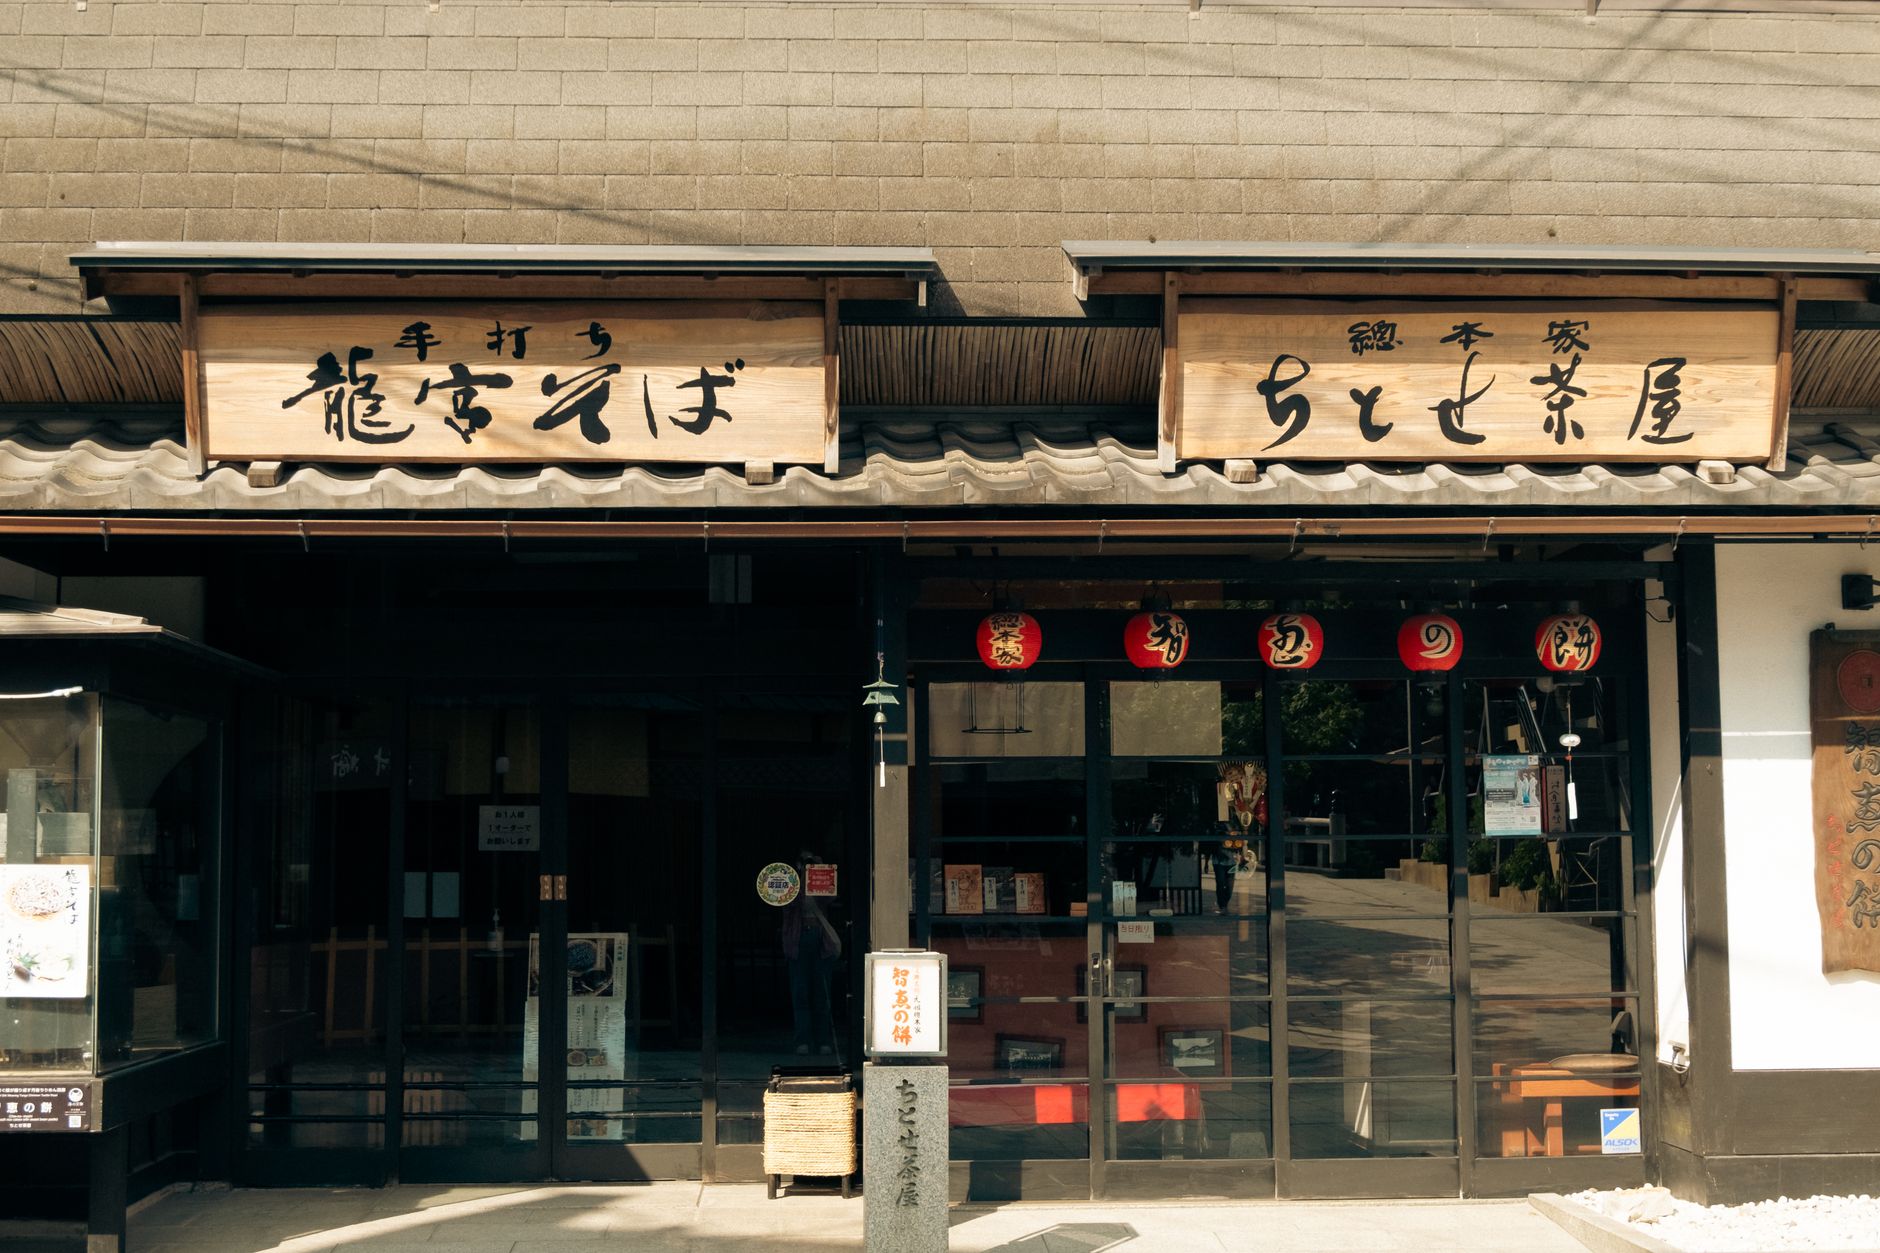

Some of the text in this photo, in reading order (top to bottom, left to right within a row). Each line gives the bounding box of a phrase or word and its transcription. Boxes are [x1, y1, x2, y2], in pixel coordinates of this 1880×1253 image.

[394, 321, 613, 361] 手打ち
[282, 345, 746, 446] 龍宮そば
[1255, 351, 1695, 451] ちとせ茶屋
[1421, 621, 1455, 657] の
[896, 1079, 921, 1207] ちとせ茶屋
[1605, 1138, 1639, 1147] ALSOK
